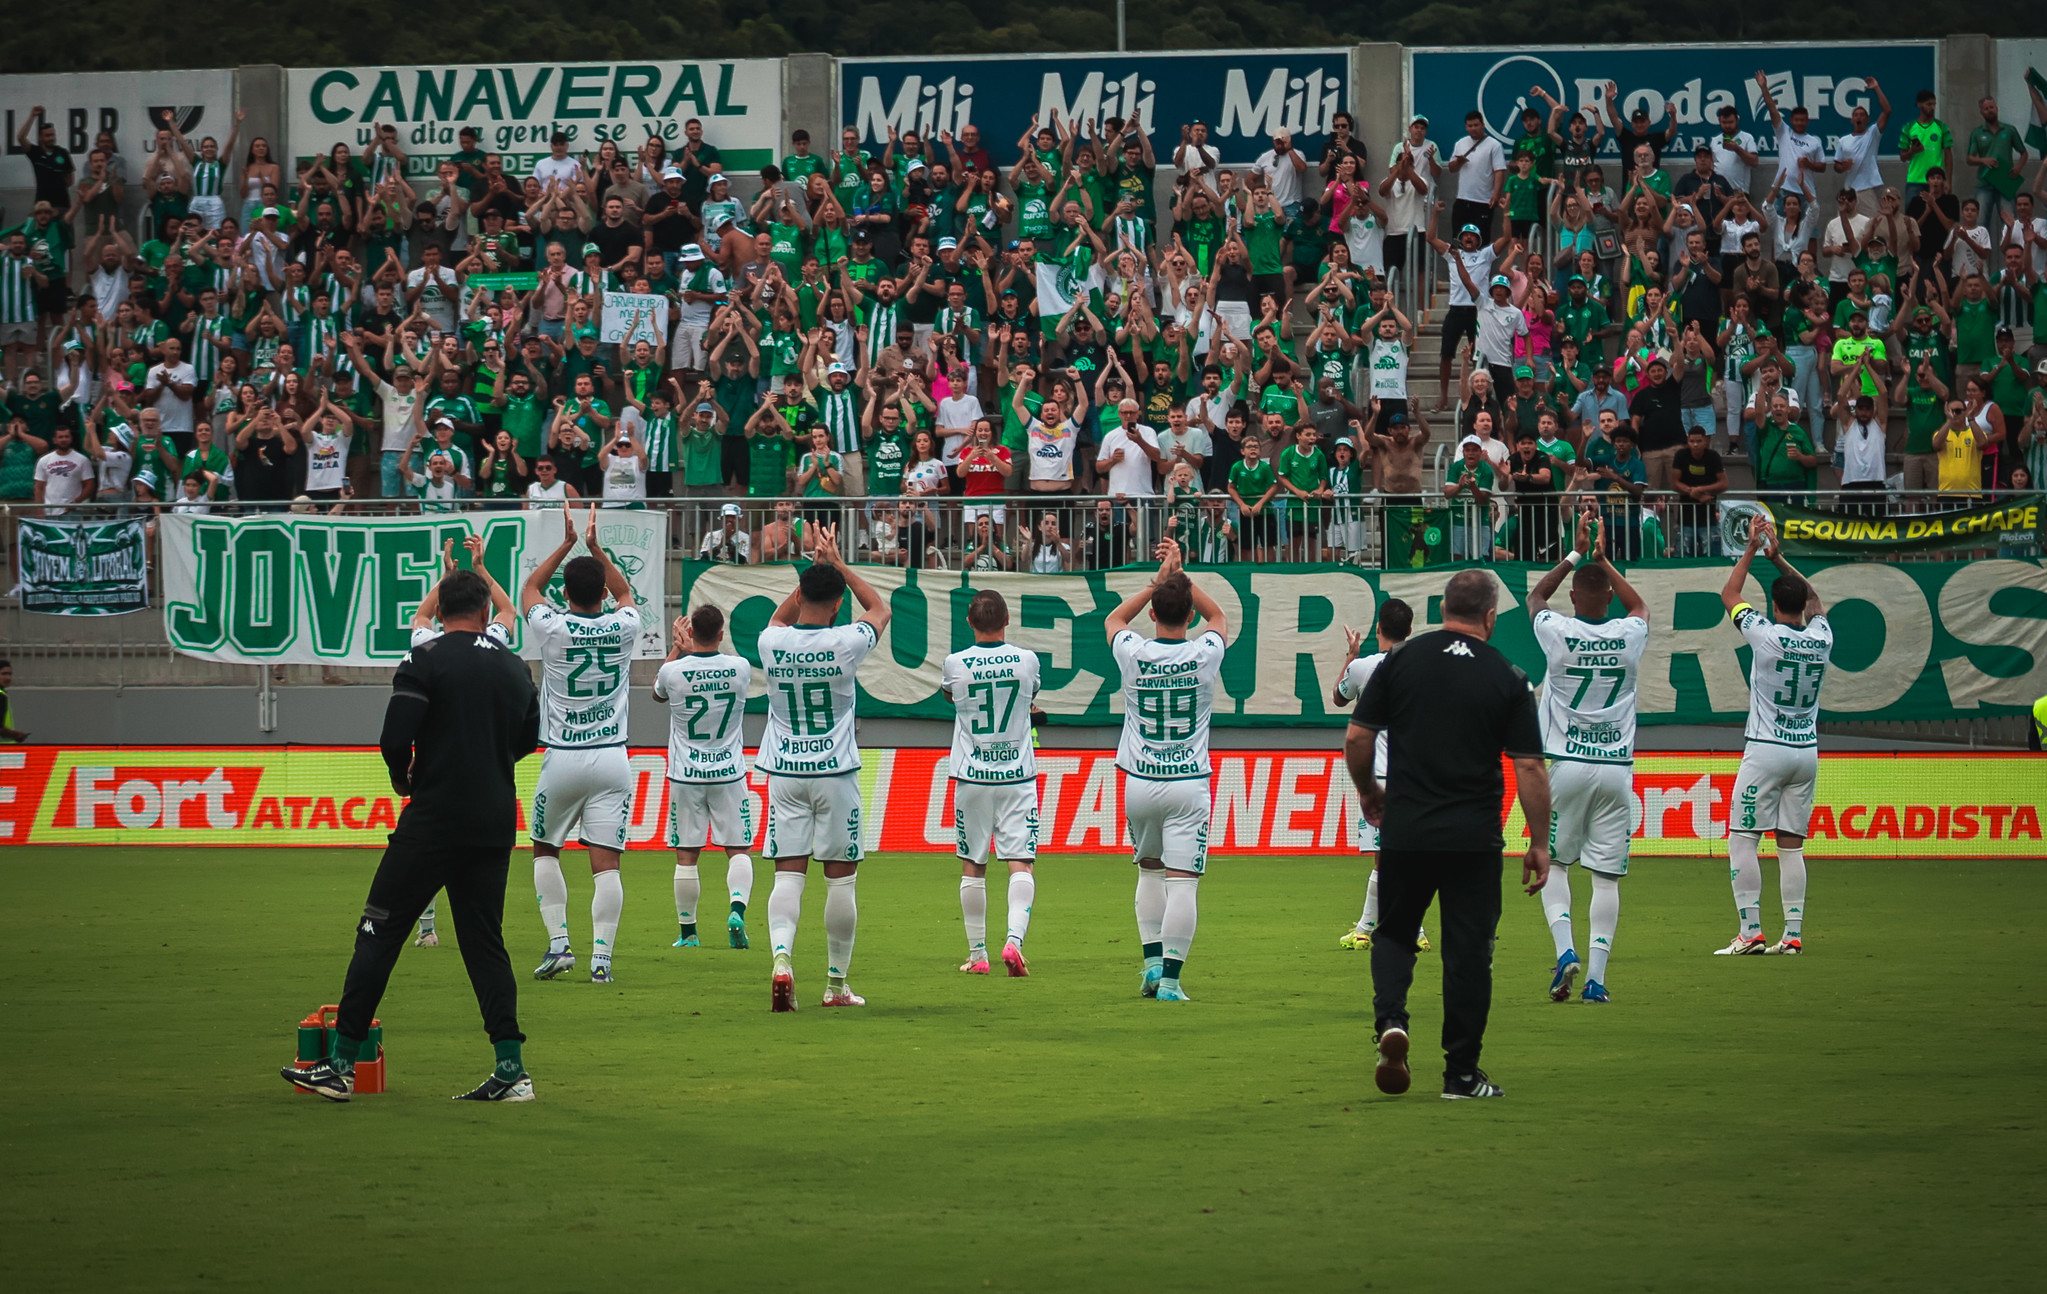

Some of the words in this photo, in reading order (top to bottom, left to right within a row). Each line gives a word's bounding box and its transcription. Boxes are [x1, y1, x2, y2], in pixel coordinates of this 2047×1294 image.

[310, 63, 748, 124] CANAVERAL
[855, 74, 974, 146] Mili
[1036, 71, 1157, 138] Mili
[1216, 67, 1342, 138] Mili
[1574, 78, 1740, 126] Roda
[411, 120, 455, 145] dia
[495, 120, 579, 151] gente
[593, 122, 628, 142] se
[643, 118, 680, 142] vê
[603, 294, 665, 309] CARVALHEIRA
[624, 319, 645, 331] SA
[1374, 362, 1400, 370] aurora
[875, 451, 903, 460] Aurora
[1036, 450, 1063, 458] aurora
[1783, 519, 1898, 541] ESQUINA
[1906, 520, 1944, 539] DA
[1951, 506, 2039, 534] CHAPE
[168, 517, 525, 657] JOVEM
[579, 622, 621, 636] SICOOB
[572, 634, 621, 646] V.CAETANO
[1578, 638, 1626, 652] SICOOB
[1790, 639, 1827, 649] SICOOB
[786, 650, 835, 664] SICOOB
[976, 654, 1021, 667] SICOOB
[1577, 656, 1619, 667] ITALO
[1783, 652, 1814, 662] BRUNO
[566, 647, 621, 697] 25
[696, 668, 737, 680] SICOOB
[767, 666, 794, 678] NETO
[797, 665, 843, 678] PESSOA
[972, 668, 1014, 681] W.CLAR
[1150, 660, 1198, 675] SICOOB
[692, 681, 730, 693] CAMILO
[1135, 676, 1200, 689] CARVALHEIRA
[1566, 668, 1626, 710] 77
[1774, 659, 1825, 709] 33
[778, 682, 835, 736] 18
[968, 679, 1021, 735] 37
[1137, 687, 1197, 742] 99
[579, 707, 616, 725] BUGIO
[685, 692, 737, 741] 27
[561, 722, 619, 742] Unimed
[1580, 730, 1622, 744] BUGIO
[1774, 728, 1817, 742] Unimd
[791, 738, 834, 755] BUGIO
[1565, 741, 1628, 758] Unimed
[701, 751, 732, 763] BUO
[982, 748, 1019, 762] BUGIO
[684, 764, 737, 779] Unimed
[774, 756, 839, 772] Unimed
[1136, 759, 1200, 775] Unimed
[967, 765, 1024, 780] Unimed
[75, 767, 241, 829] Fort
[1741, 785, 1758, 815] alfa
[740, 798, 751, 829] alfa
[847, 808, 860, 842] alfa
[1196, 821, 1209, 855] alfa
